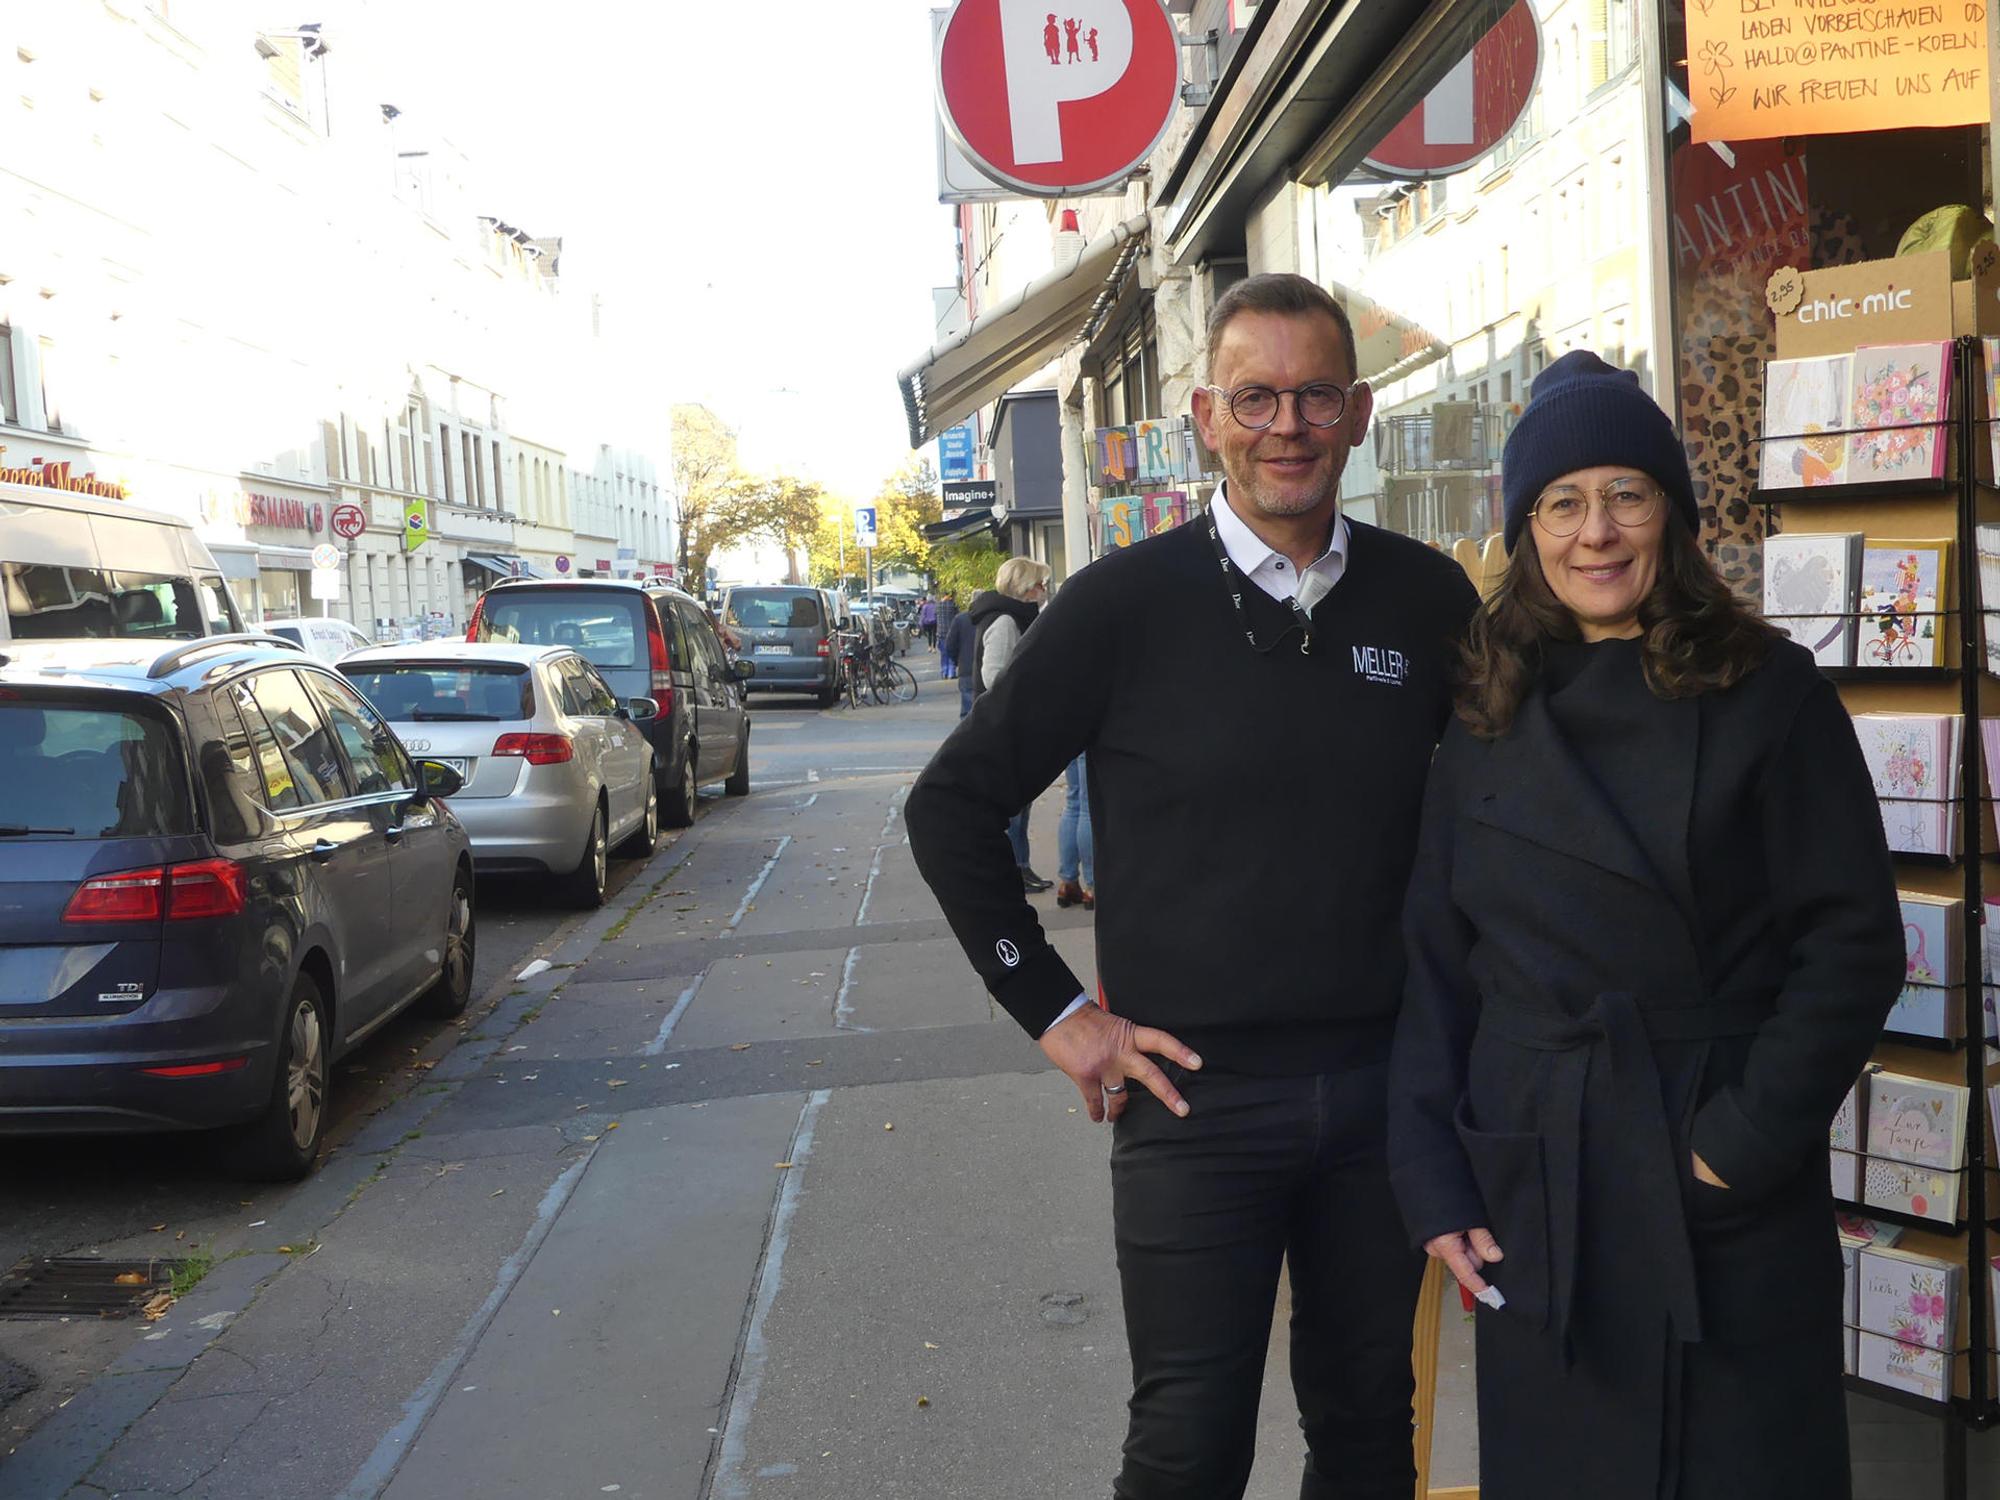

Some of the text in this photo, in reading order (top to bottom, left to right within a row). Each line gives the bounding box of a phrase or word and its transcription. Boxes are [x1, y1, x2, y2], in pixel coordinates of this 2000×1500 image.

[1742, 18, 1791, 40] LADEN
[1799, 77, 1878, 103] FREUEN
[1896, 73, 1931, 96] UNS
[1942, 67, 1982, 92] AUF
[1770, 279, 1795, 302] 2,95
[1352, 645, 1403, 680] MELLER
